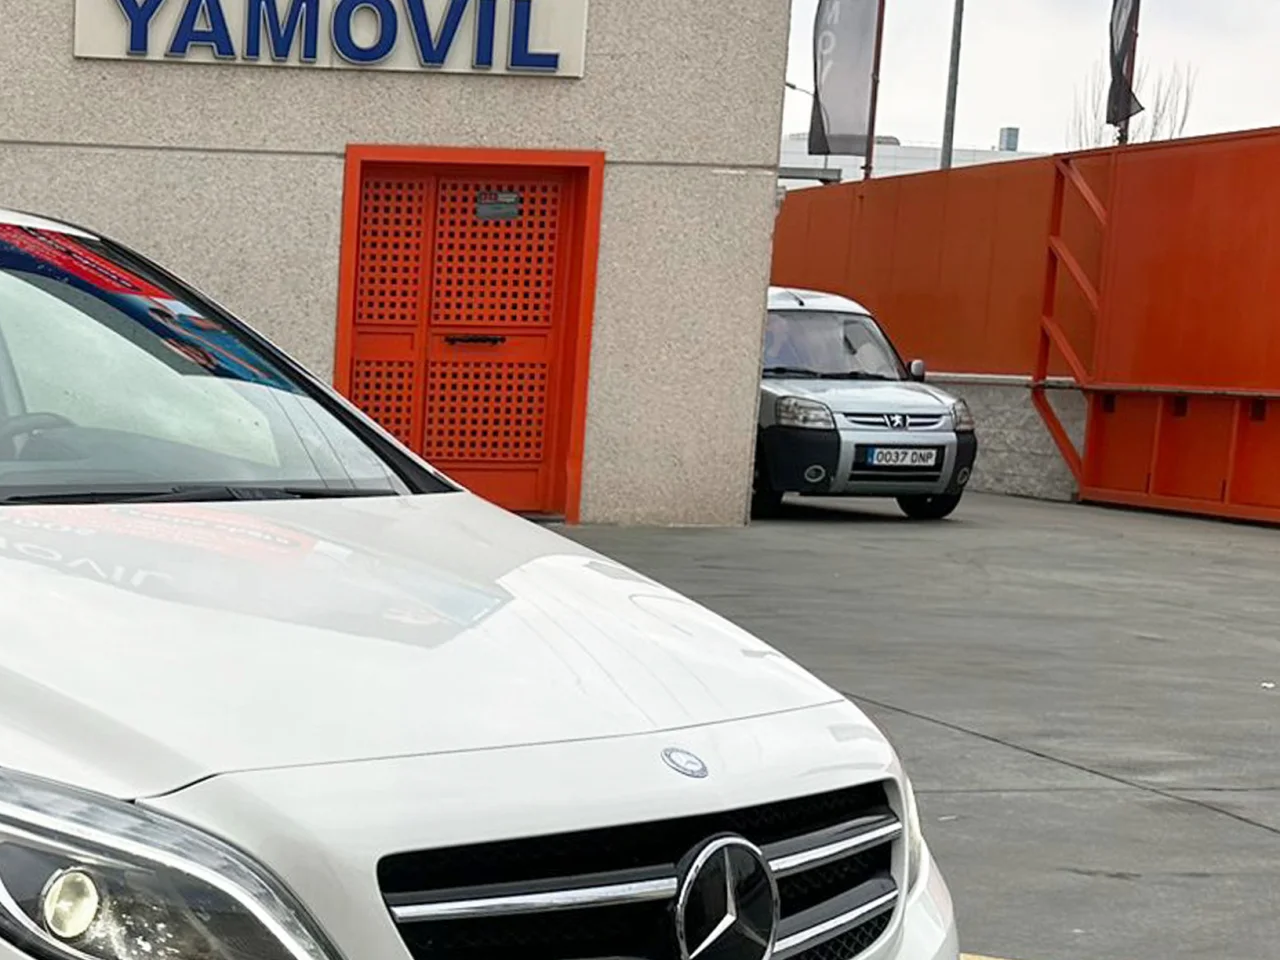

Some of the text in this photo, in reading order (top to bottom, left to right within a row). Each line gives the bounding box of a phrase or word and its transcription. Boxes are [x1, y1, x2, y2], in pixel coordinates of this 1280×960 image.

[114, 0, 560, 71] YAMOVIL
[876, 450, 934, 464] 0037 DNP
